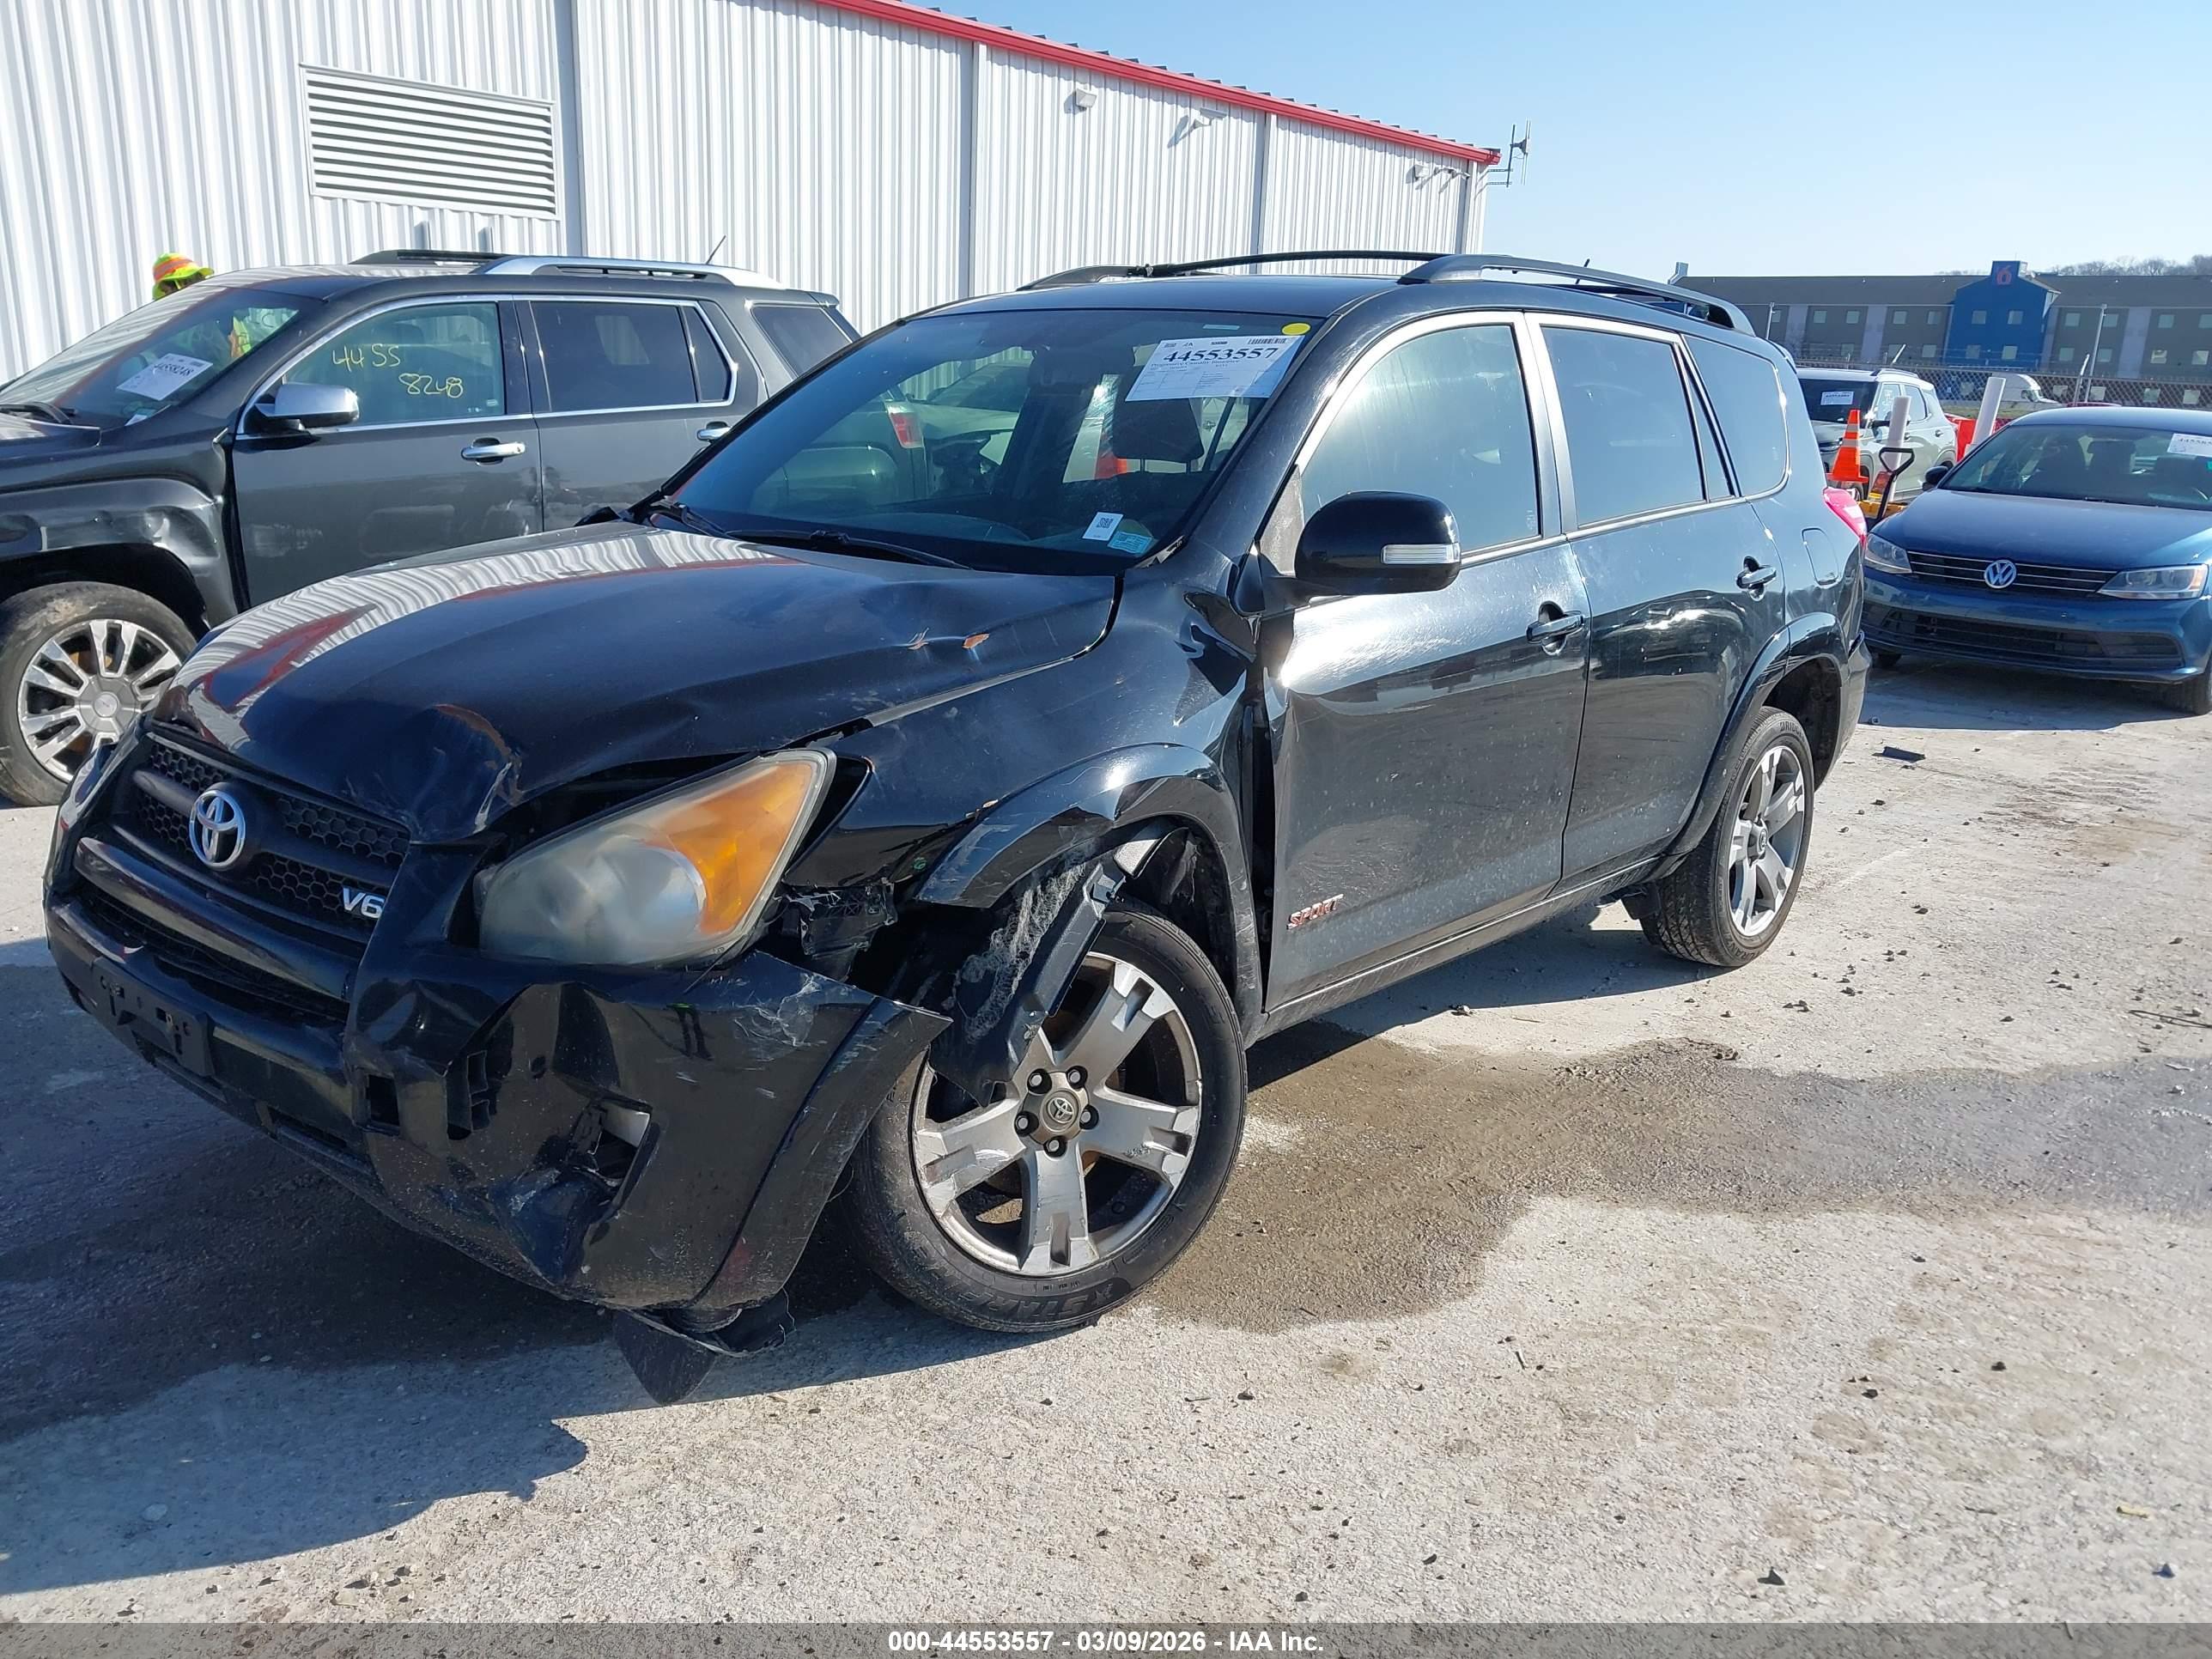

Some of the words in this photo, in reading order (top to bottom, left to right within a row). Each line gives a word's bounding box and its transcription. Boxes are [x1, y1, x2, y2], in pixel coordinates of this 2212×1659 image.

[1163, 347, 1279, 362] 44553557
[343, 886, 386, 919] V6
[1287, 894, 1344, 929] SPORT
